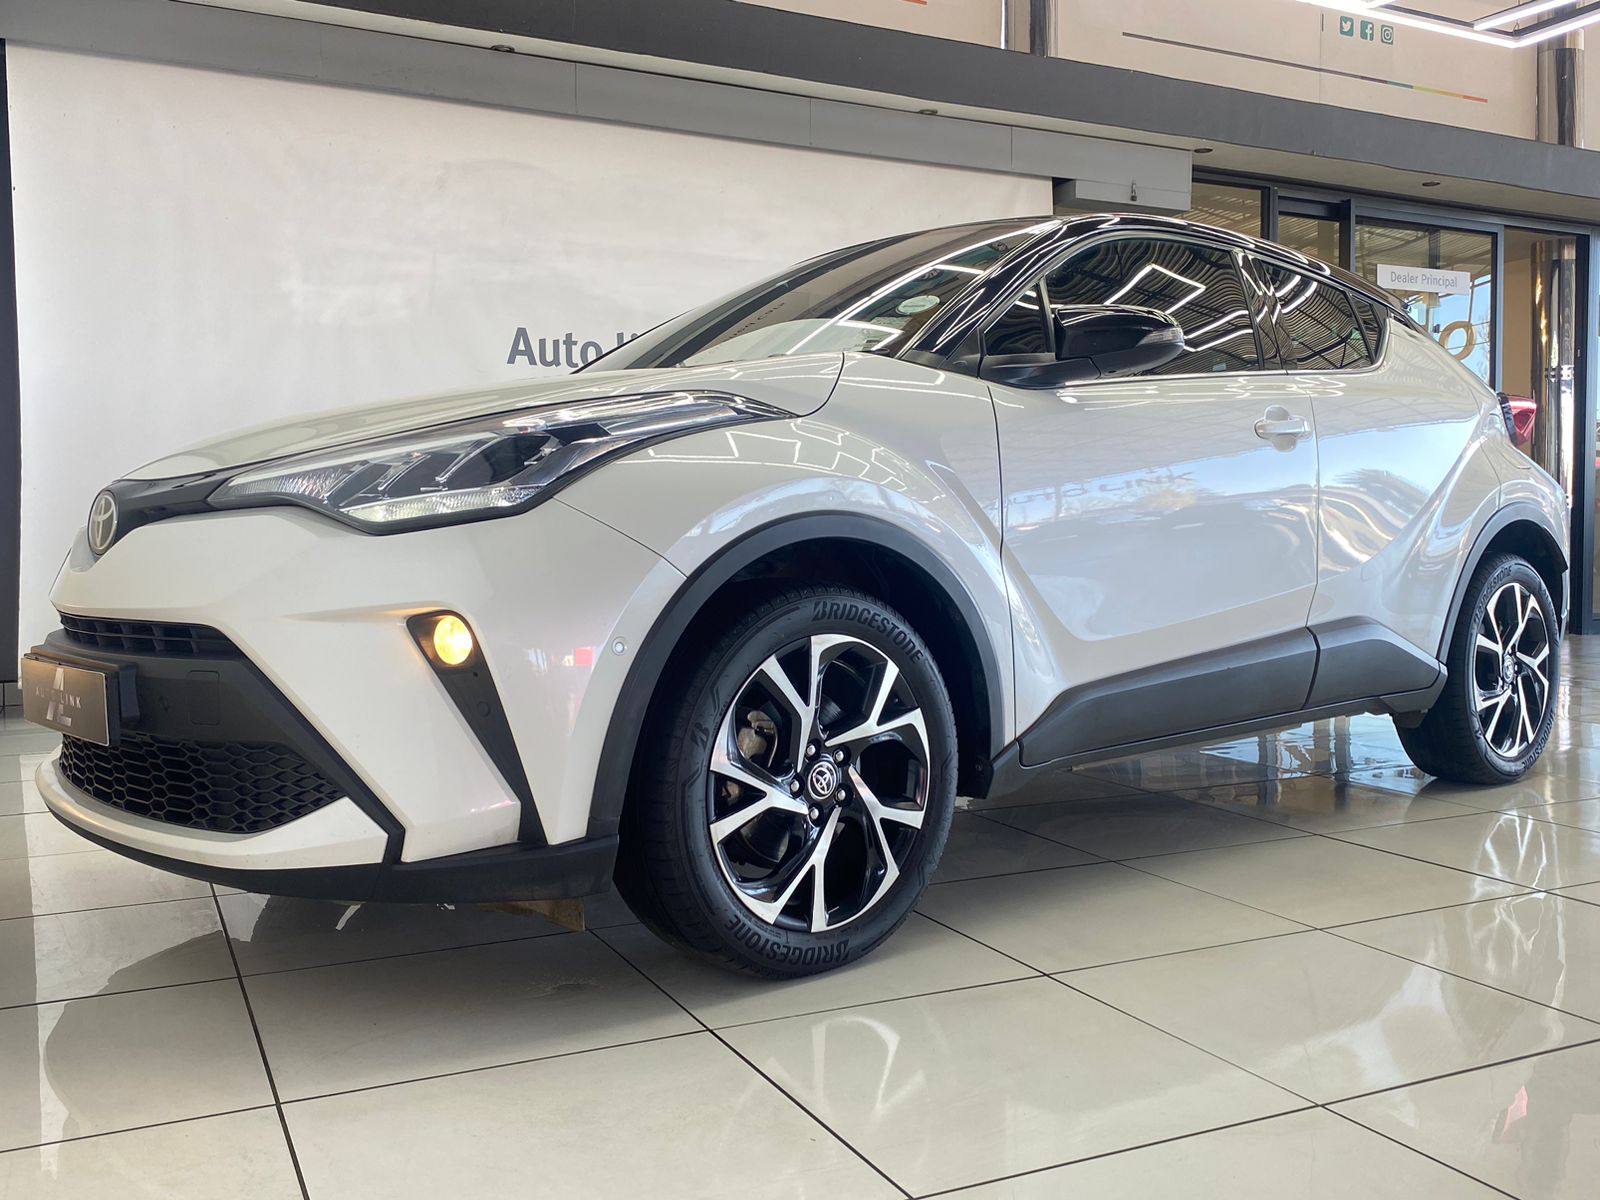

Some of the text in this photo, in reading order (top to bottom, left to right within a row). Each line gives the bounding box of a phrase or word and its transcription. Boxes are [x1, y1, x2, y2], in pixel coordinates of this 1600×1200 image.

[1390, 271, 1458, 289] Dealer Principal
[506, 327, 604, 369] Auto
[811, 600, 924, 665] BRIDGESTONE
[60, 693, 82, 709] LINK
[724, 914, 850, 967] BRIDGESTONE
